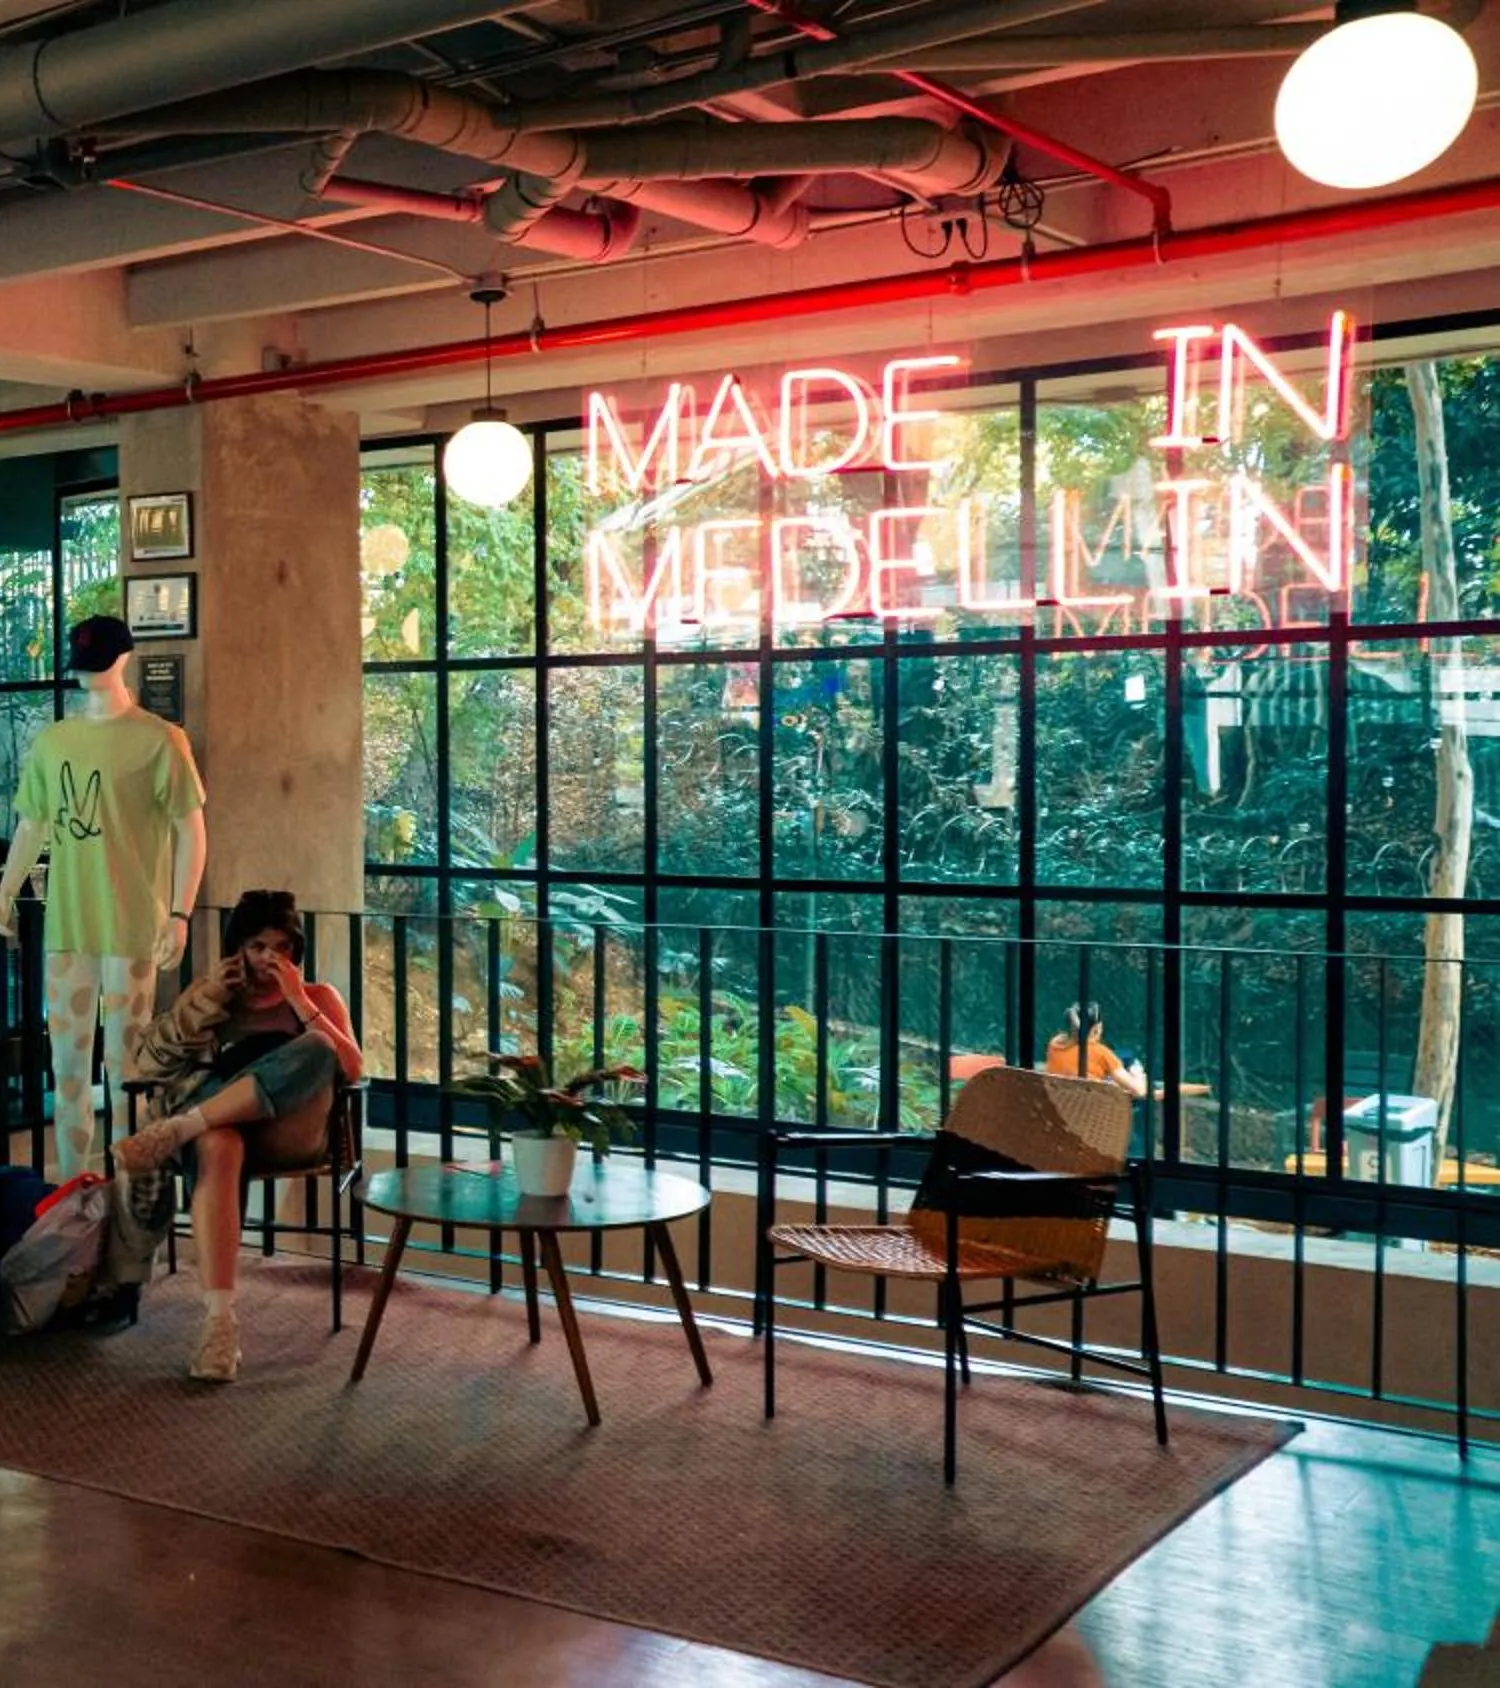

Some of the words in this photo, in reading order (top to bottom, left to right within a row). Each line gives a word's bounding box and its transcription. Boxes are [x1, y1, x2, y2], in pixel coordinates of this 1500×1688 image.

[587, 356, 964, 494] MADE
[1152, 310, 1348, 447] IN
[587, 463, 1350, 627] MEDELLIN
